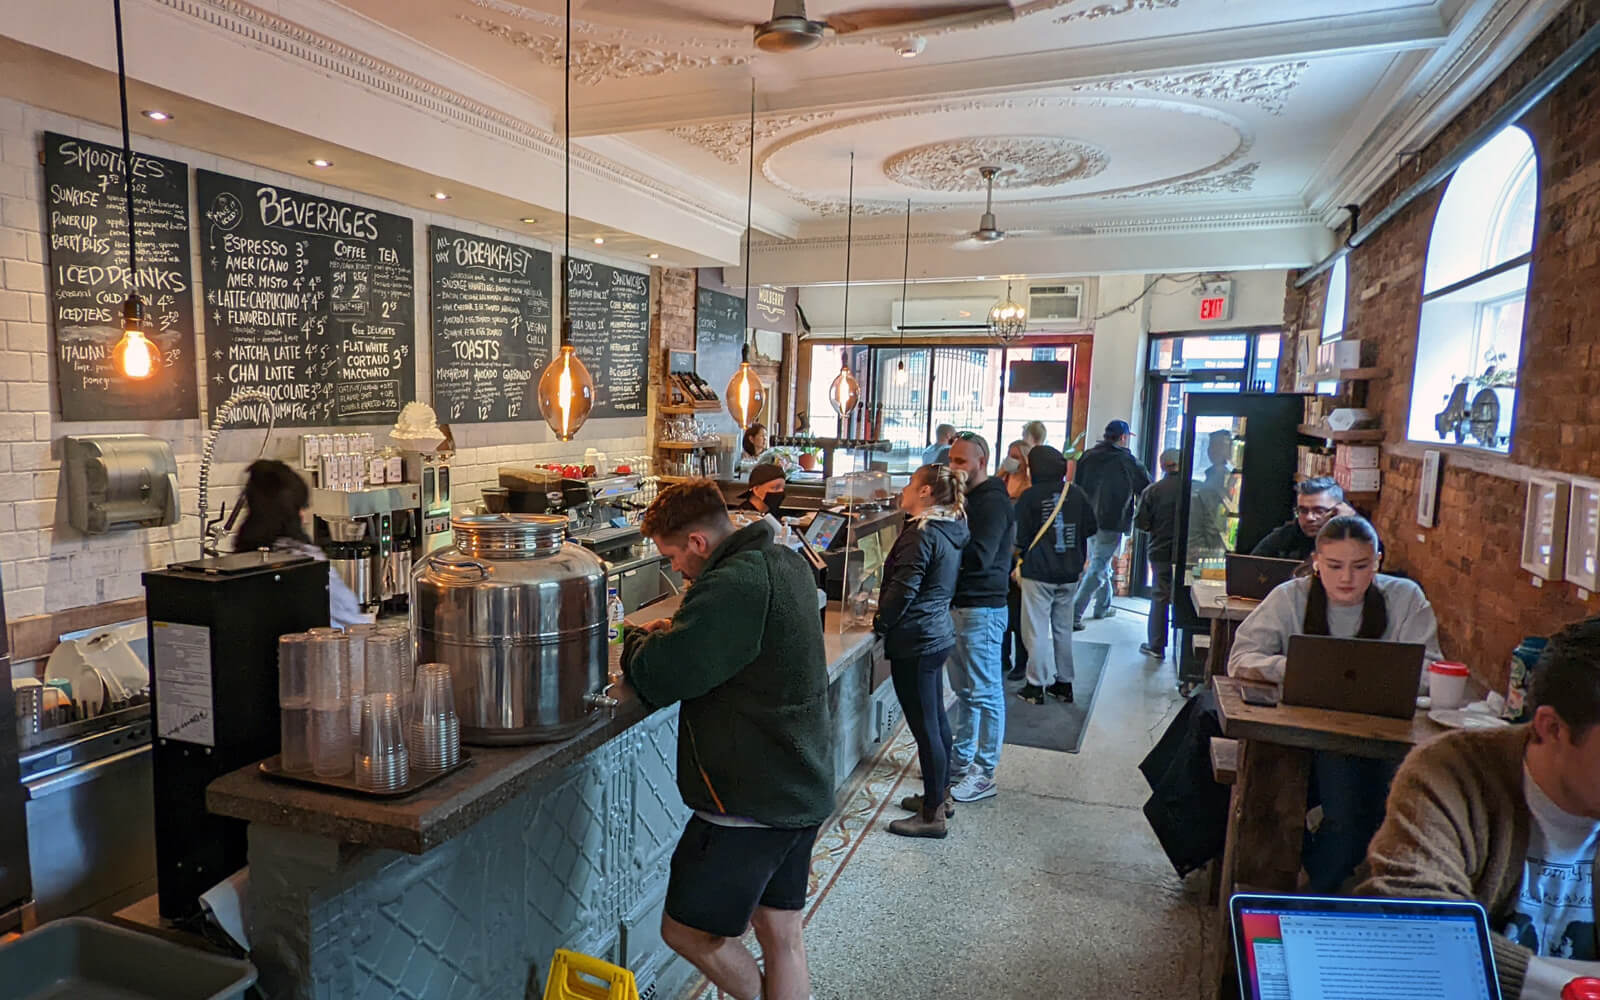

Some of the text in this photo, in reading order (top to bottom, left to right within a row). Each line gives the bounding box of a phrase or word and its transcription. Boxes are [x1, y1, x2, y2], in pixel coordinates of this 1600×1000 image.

[50, 184, 99, 208] SUNRISE
[257, 187, 378, 241] BEVERAGES
[82, 216, 97, 238] UP
[51, 233, 83, 254] BERRY
[223, 233, 289, 258] ESPRESSO
[334, 240, 368, 260] COFFEE
[225, 255, 290, 274] AMERICANO
[378, 247, 400, 265] TEA
[435, 250, 450, 263] DAY
[437, 237, 533, 274] ALL BREAKFAST
[59, 265, 105, 286] ICED
[568, 259, 594, 283] SALADS
[259, 275, 289, 289] MISTO
[441, 277, 467, 291] SAUSAGE
[95, 290, 122, 305] COLD
[59, 305, 83, 323] ICED
[82, 307, 113, 322] TEAS
[1200, 298, 1225, 320] EXIT
[227, 309, 271, 328] FLAVORED
[271, 311, 298, 329] LATTE
[526, 320, 547, 336] VEGAN
[343, 339, 389, 353] FLAT WHITE
[526, 334, 545, 346] CHILI
[61, 344, 105, 363] ITALIAN
[228, 344, 272, 363] MATCHA
[273, 346, 302, 361] LATTE
[451, 339, 500, 362] TOASTS
[346, 353, 391, 368] CORTADO
[228, 363, 259, 384] CHAI
[265, 365, 296, 382] LATTE
[342, 366, 391, 381] MACCHIATO
[290, 402, 308, 422] FOG
